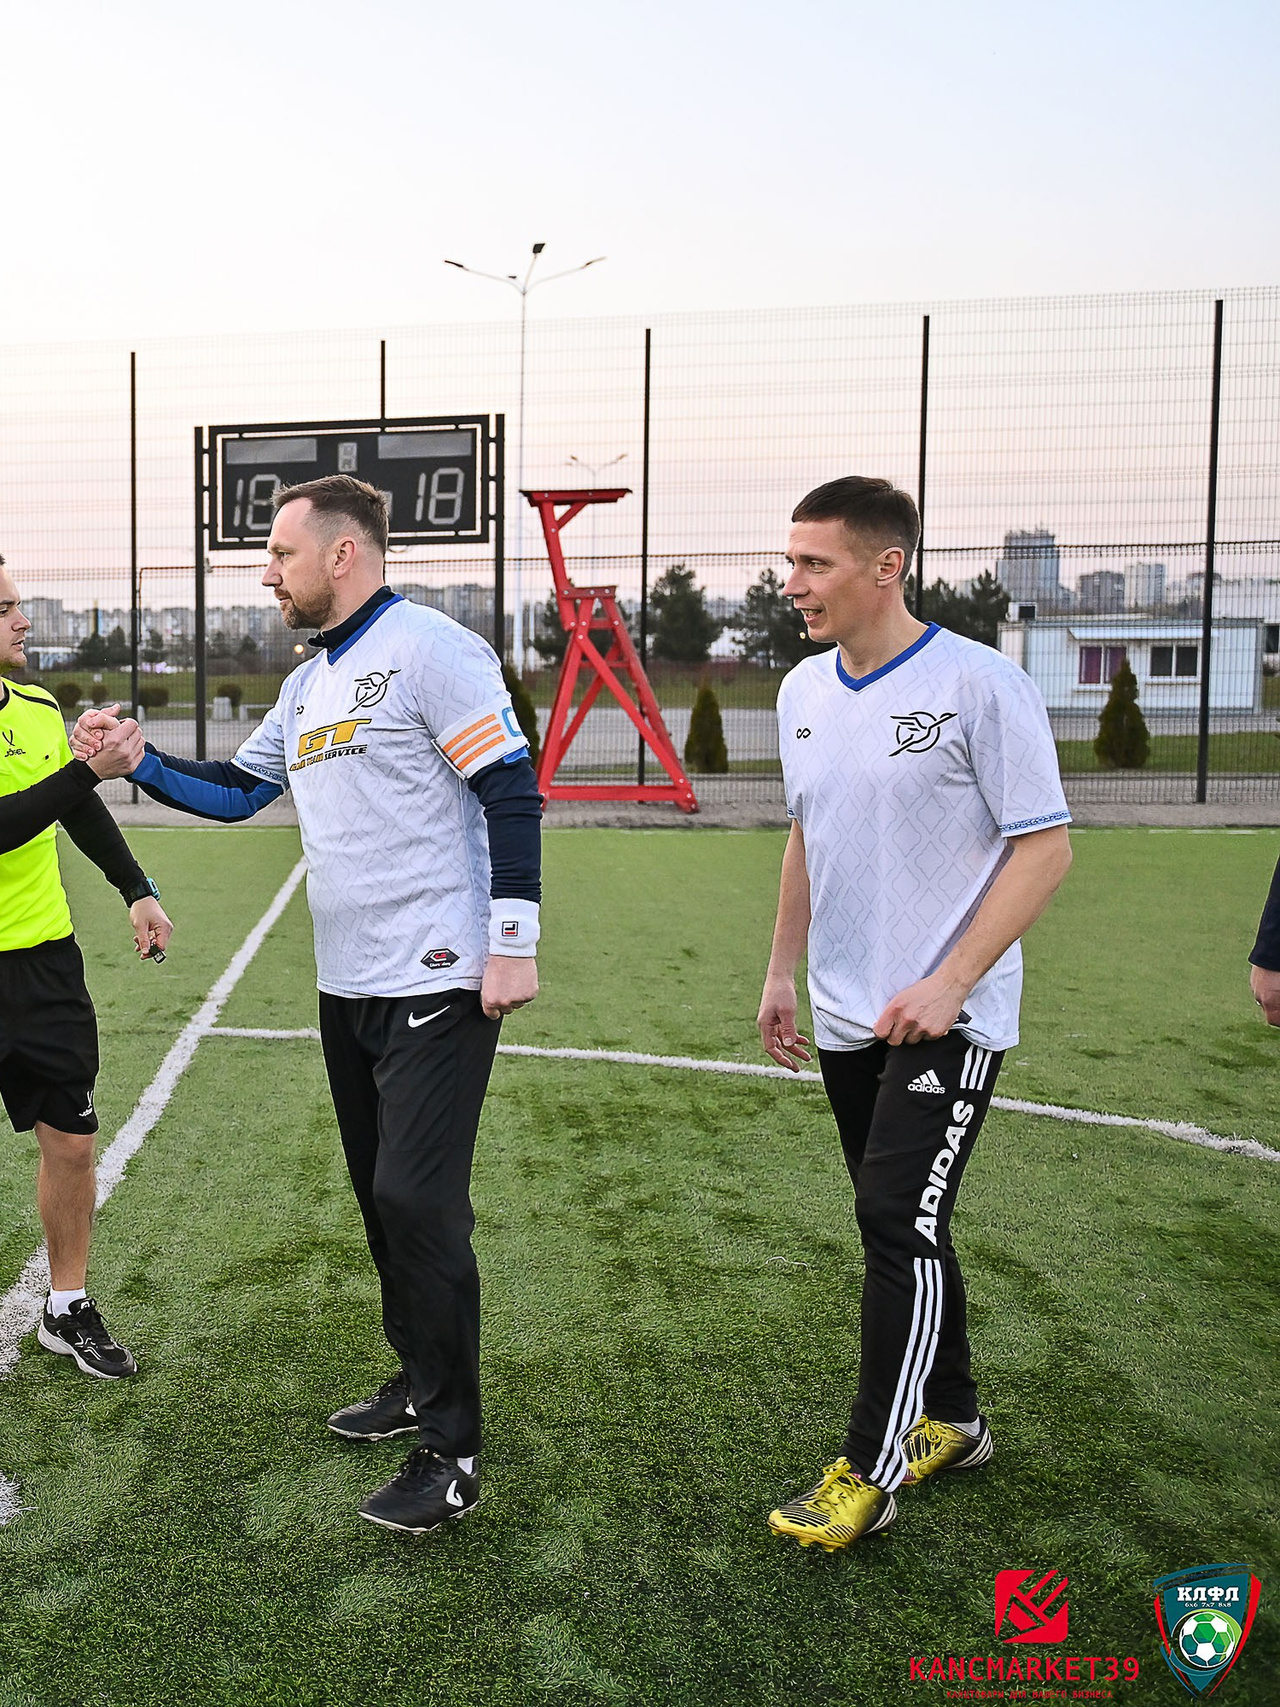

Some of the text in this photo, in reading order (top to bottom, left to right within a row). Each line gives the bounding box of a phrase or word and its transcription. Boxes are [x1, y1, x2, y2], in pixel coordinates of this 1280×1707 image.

[415, 467, 465, 525] 18
[298, 718, 373, 759] GT
[324, 747, 368, 761] SERVICE
[907, 1083, 946, 1094] adidas
[914, 1100, 975, 1247] ADIDAS
